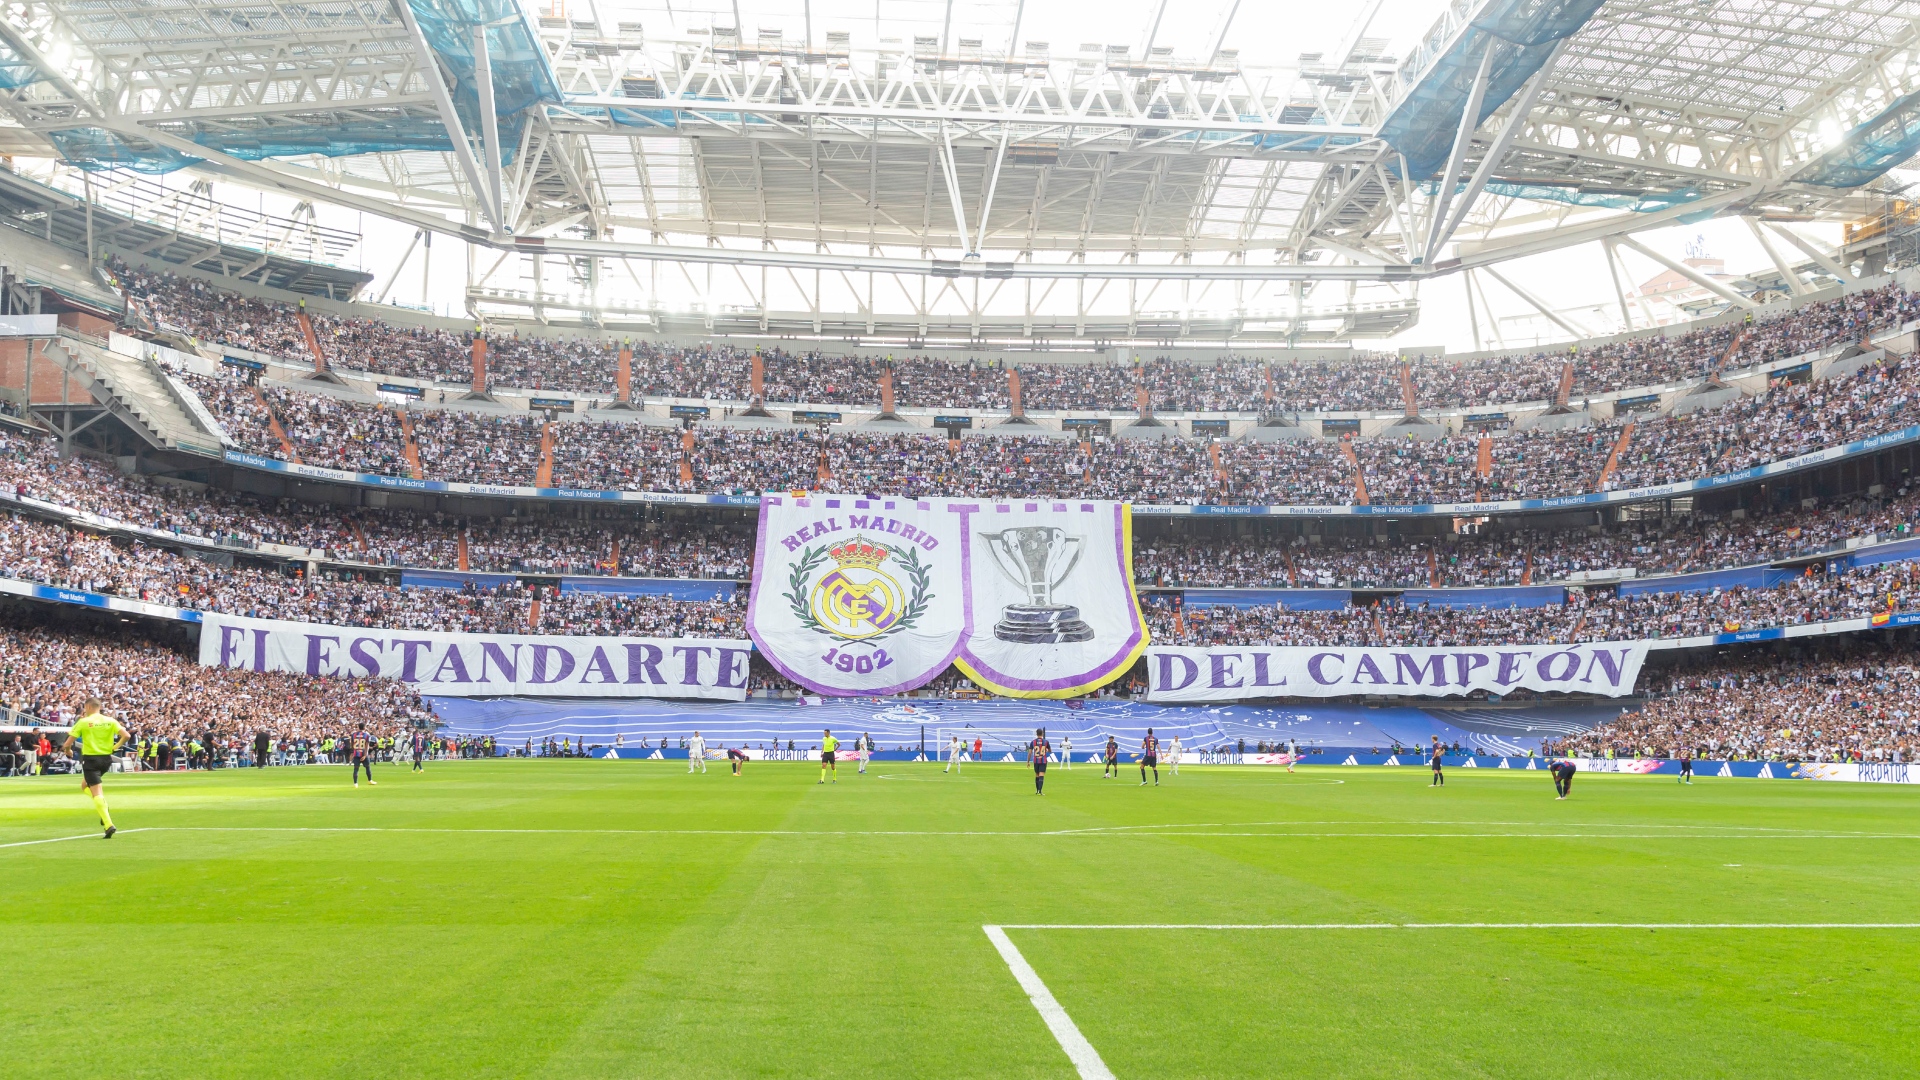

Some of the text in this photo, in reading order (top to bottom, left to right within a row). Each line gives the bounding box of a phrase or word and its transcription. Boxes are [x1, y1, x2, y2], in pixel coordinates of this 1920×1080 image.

[1864, 431, 1904, 448] Real Madrid
[226, 452, 266, 467] Real Madrid
[1786, 454, 1824, 469] Real Madrid
[298, 467, 344, 479] Real Madrid
[1712, 471, 1750, 484] Real Madrid
[380, 477, 425, 488] Real Madrid
[1629, 487, 1673, 498] Real Madrid
[1543, 496, 1585, 506] Real Madrid
[780, 515, 940, 552] REAL MADRID
[71, 593, 86, 601] Madrid
[303, 634, 750, 688] ESTANDARTE
[821, 647, 894, 674] 1902
[1154, 644, 1631, 691] DEL CAMPEÓN
[354, 739, 365, 749] 28
[1150, 742, 1154, 750] 5
[763, 749, 808, 761] PREDATOR
[1035, 746, 1045, 756] 24
[1200, 753, 1244, 764] PREDATOR
[1858, 763, 1910, 782] PREDATOR
